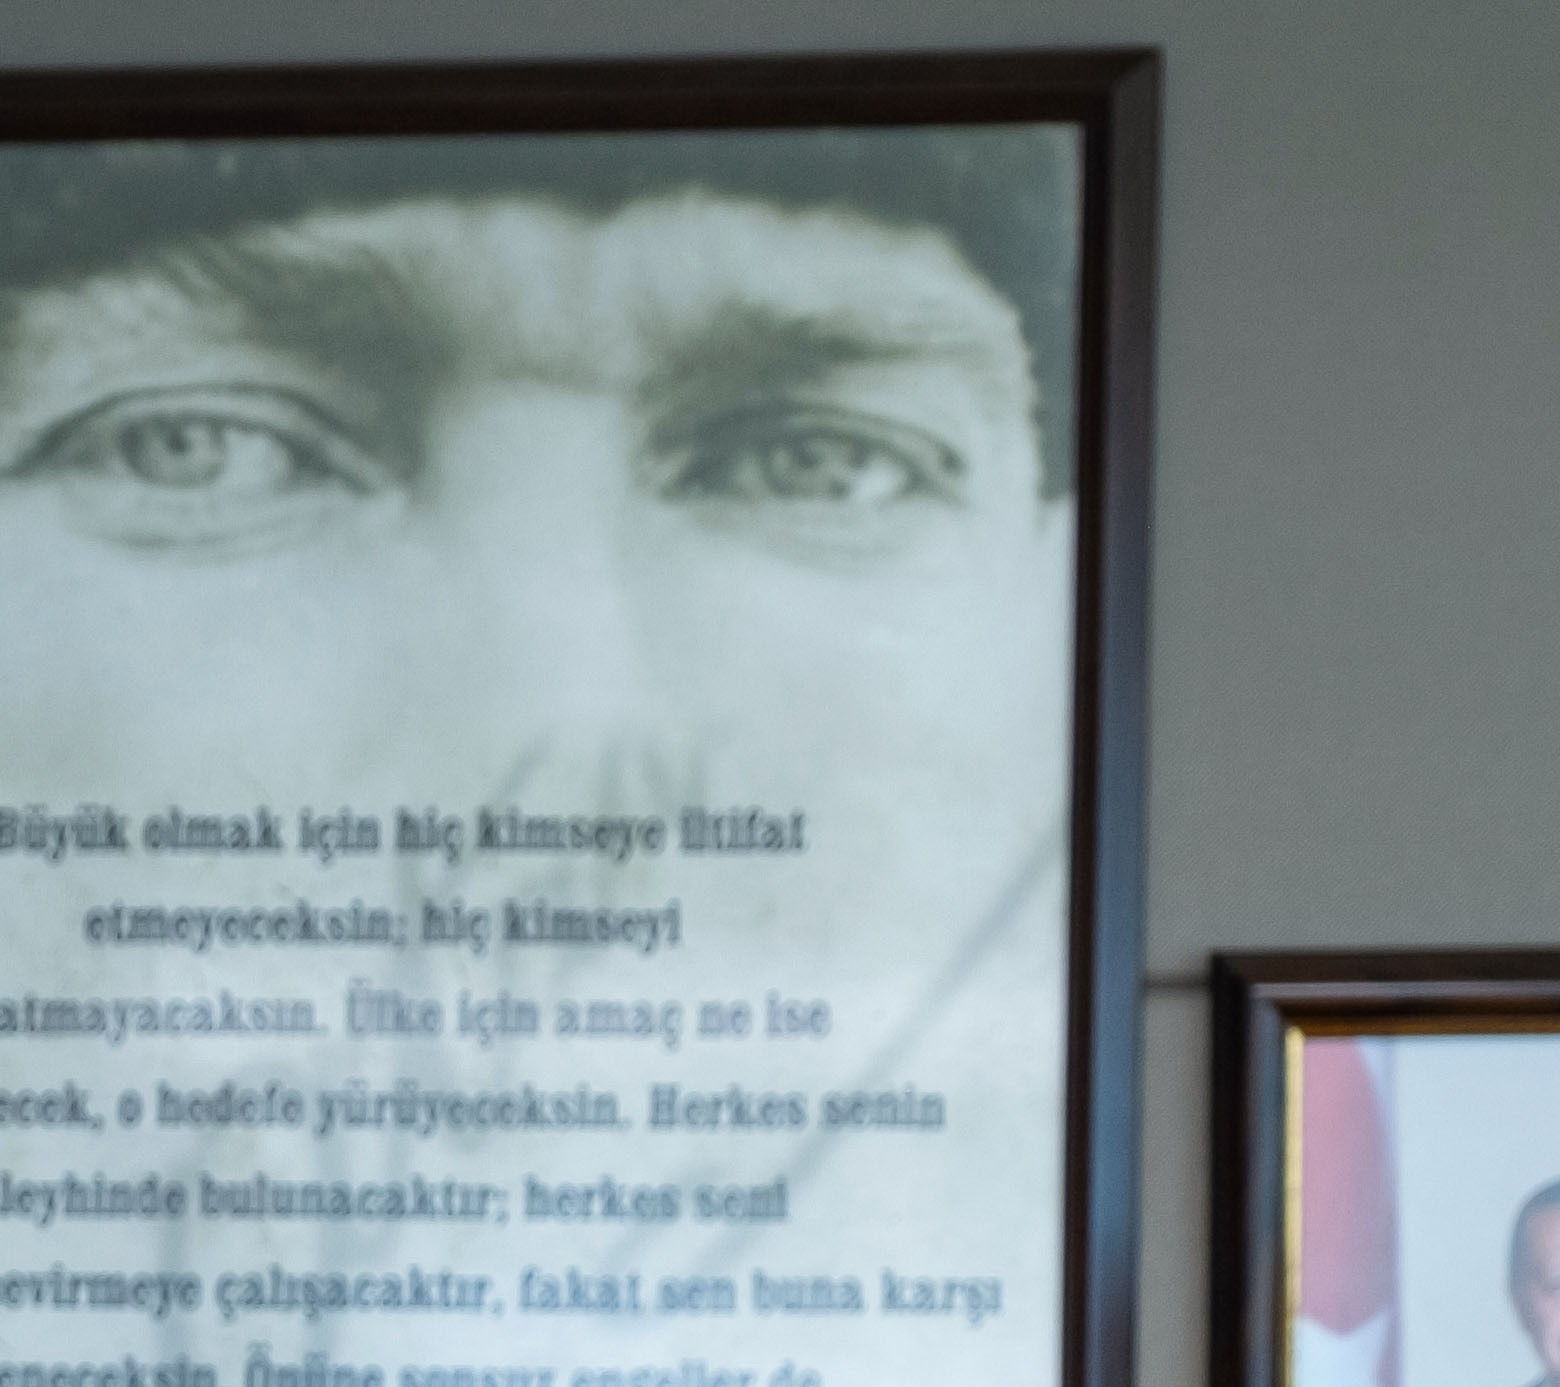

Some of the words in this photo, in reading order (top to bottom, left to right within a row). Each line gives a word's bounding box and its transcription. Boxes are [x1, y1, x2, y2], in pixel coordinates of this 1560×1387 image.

[143, 806, 283, 852] olmak
[298, 806, 379, 863] için
[395, 806, 463, 863] hiç
[476, 806, 666, 862] kimseye
[422, 899, 490, 954] hiç
[504, 899, 682, 953] kimseyi
[346, 976, 443, 1034] Ülke
[458, 990, 540, 1052] için
[555, 1000, 682, 1052] amaç
[698, 1001, 752, 1035] ne
[766, 990, 831, 1035] ise
[118, 1088, 143, 1126] o
[156, 1080, 304, 1127] hedefe
[647, 1083, 809, 1130] Herkes
[822, 1083, 946, 1129] senin
[524, 1173, 680, 1220] herkes
[695, 1176, 789, 1220] seni
[519, 1266, 643, 1313] fakat
[656, 1276, 737, 1312] sen
[751, 1268, 866, 1313] buna
[880, 1268, 1004, 1328] karşı
